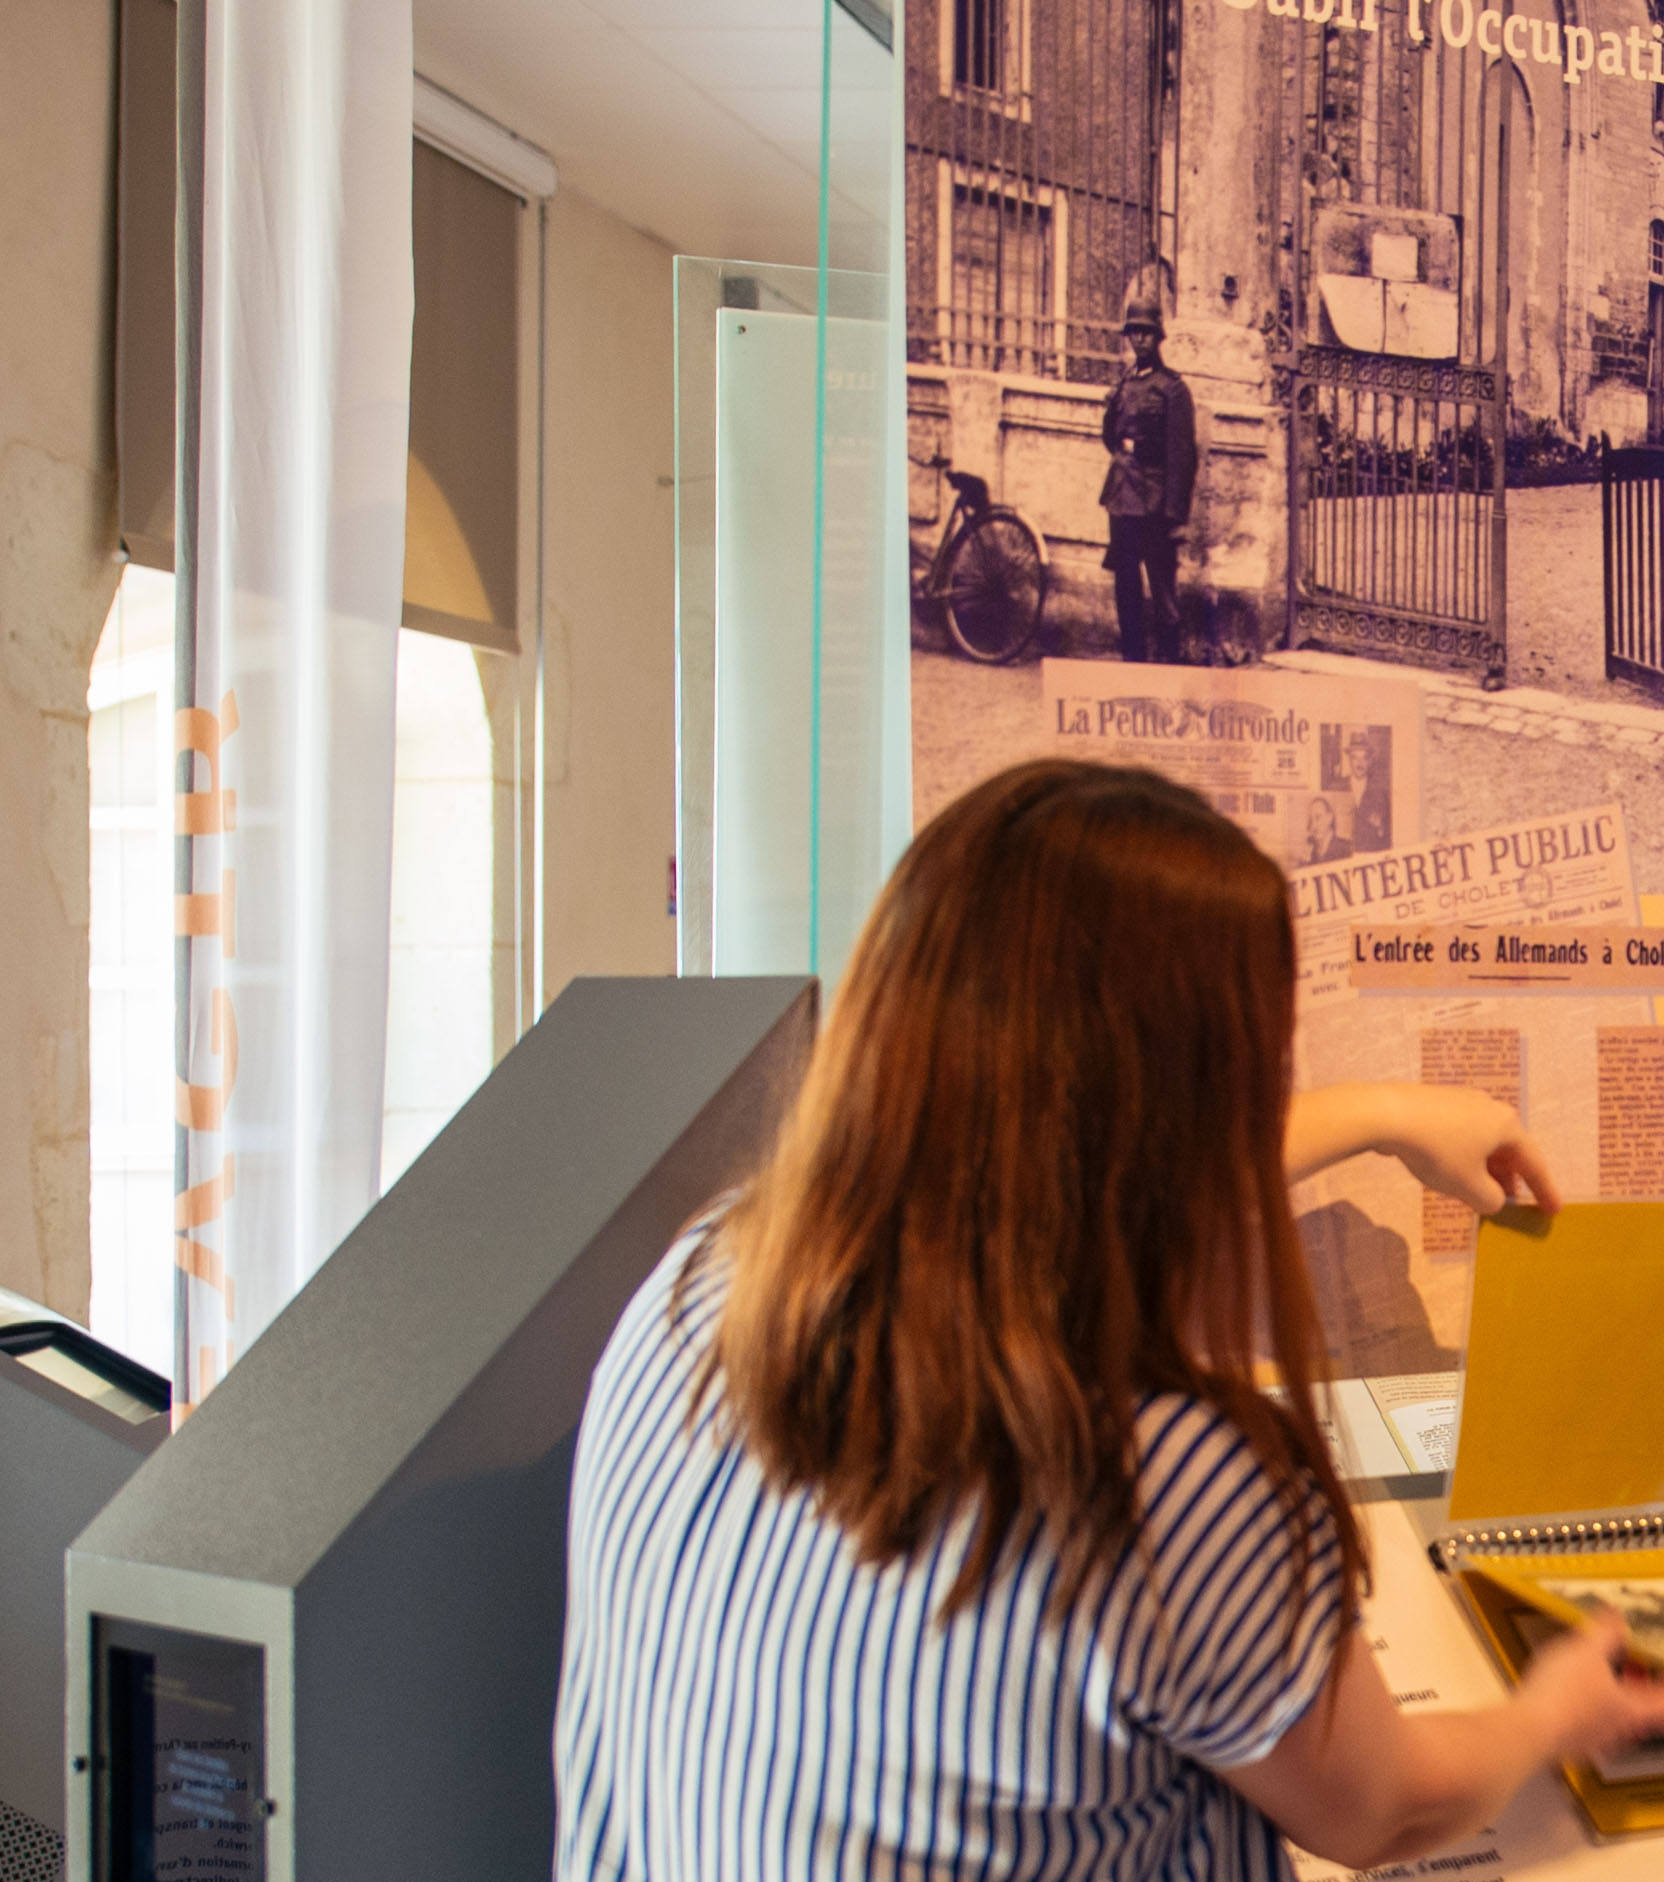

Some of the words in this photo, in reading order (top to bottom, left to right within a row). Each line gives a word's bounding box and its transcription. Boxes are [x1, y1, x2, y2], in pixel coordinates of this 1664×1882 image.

[1057, 699, 1090, 736] La
[1098, 699, 1177, 740] Petite
[1208, 708, 1310, 744] Gironde
[1486, 814, 1617, 875] PUBLIC
[1395, 900, 1425, 921] DE
[1439, 876, 1526, 909] CHOLET
[1355, 933, 1434, 963] L'entrée
[1449, 939, 1480, 963] des
[1495, 936, 1588, 964] Allemands
[1602, 938, 1613, 964] à
